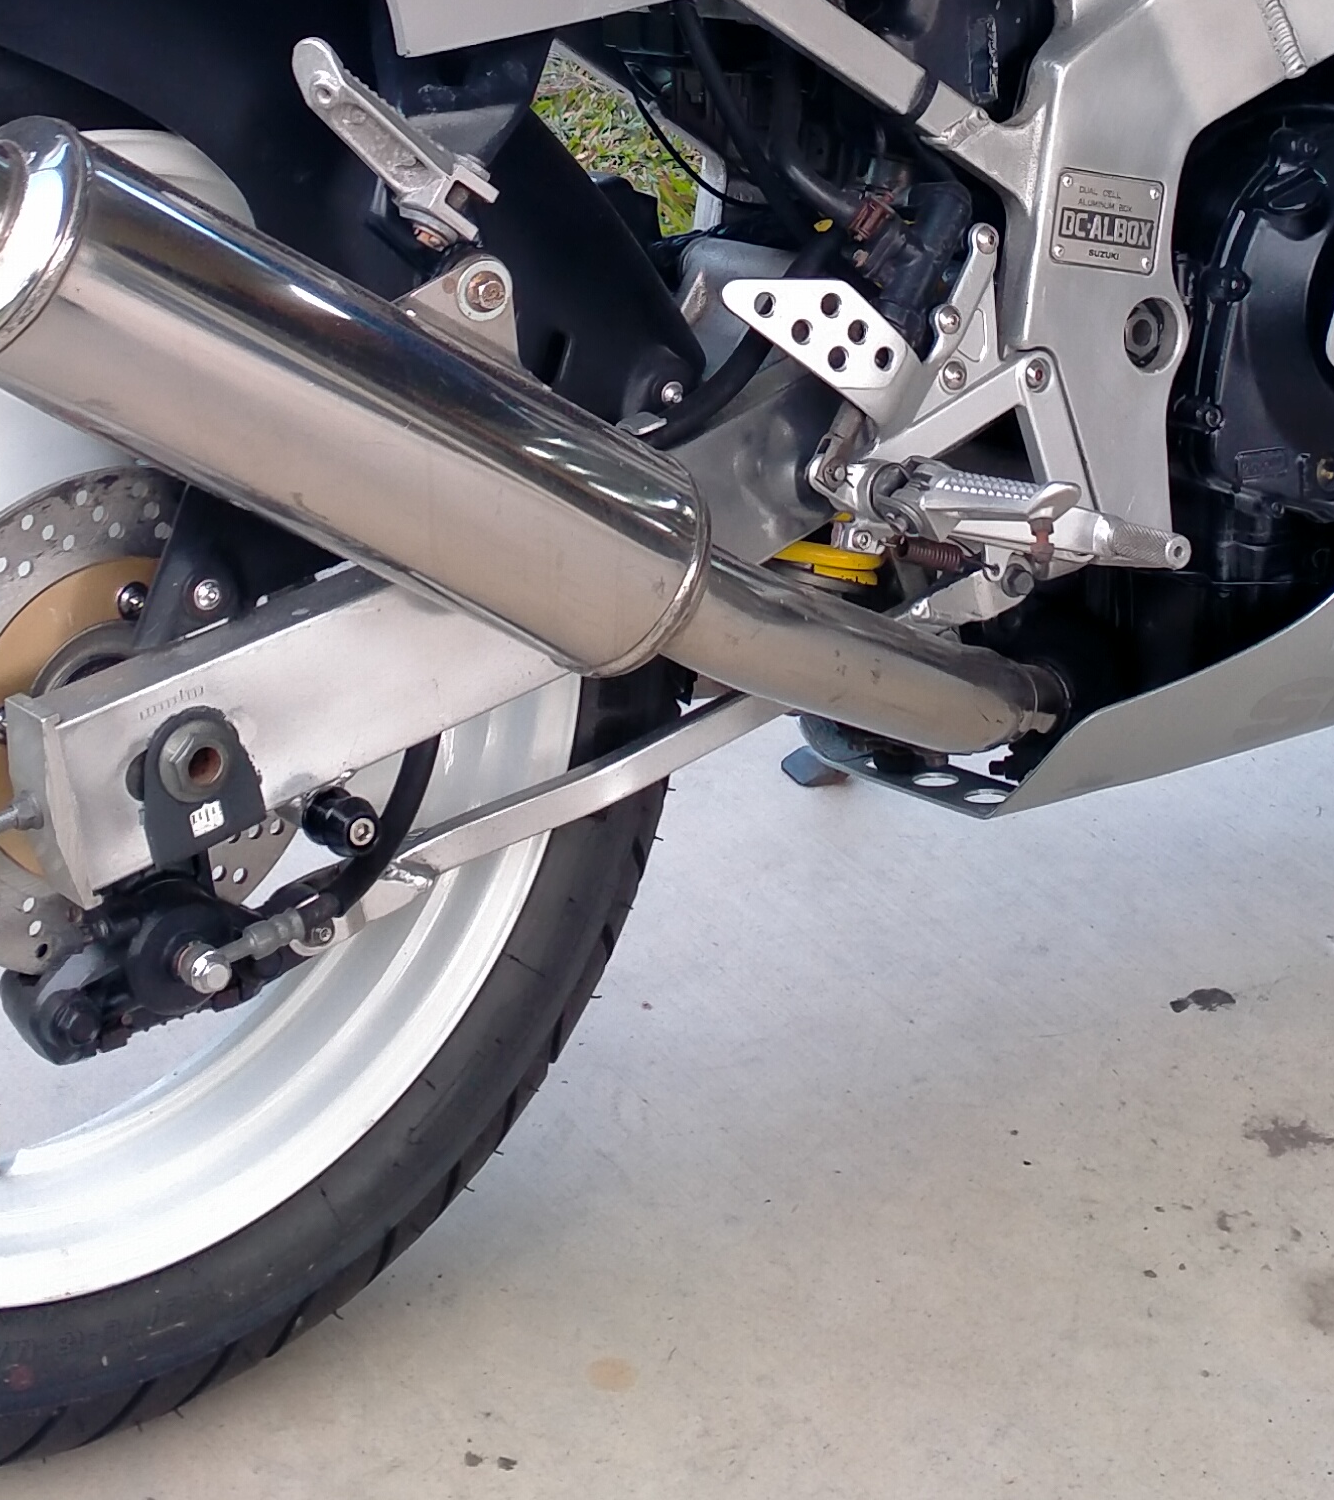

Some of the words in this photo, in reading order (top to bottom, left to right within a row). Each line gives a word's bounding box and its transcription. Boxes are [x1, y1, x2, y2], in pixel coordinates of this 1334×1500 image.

[1078, 185, 1098, 196] DUAL
[1102, 189, 1122, 200] CELL
[1088, 248, 1120, 261] SUZUKI
